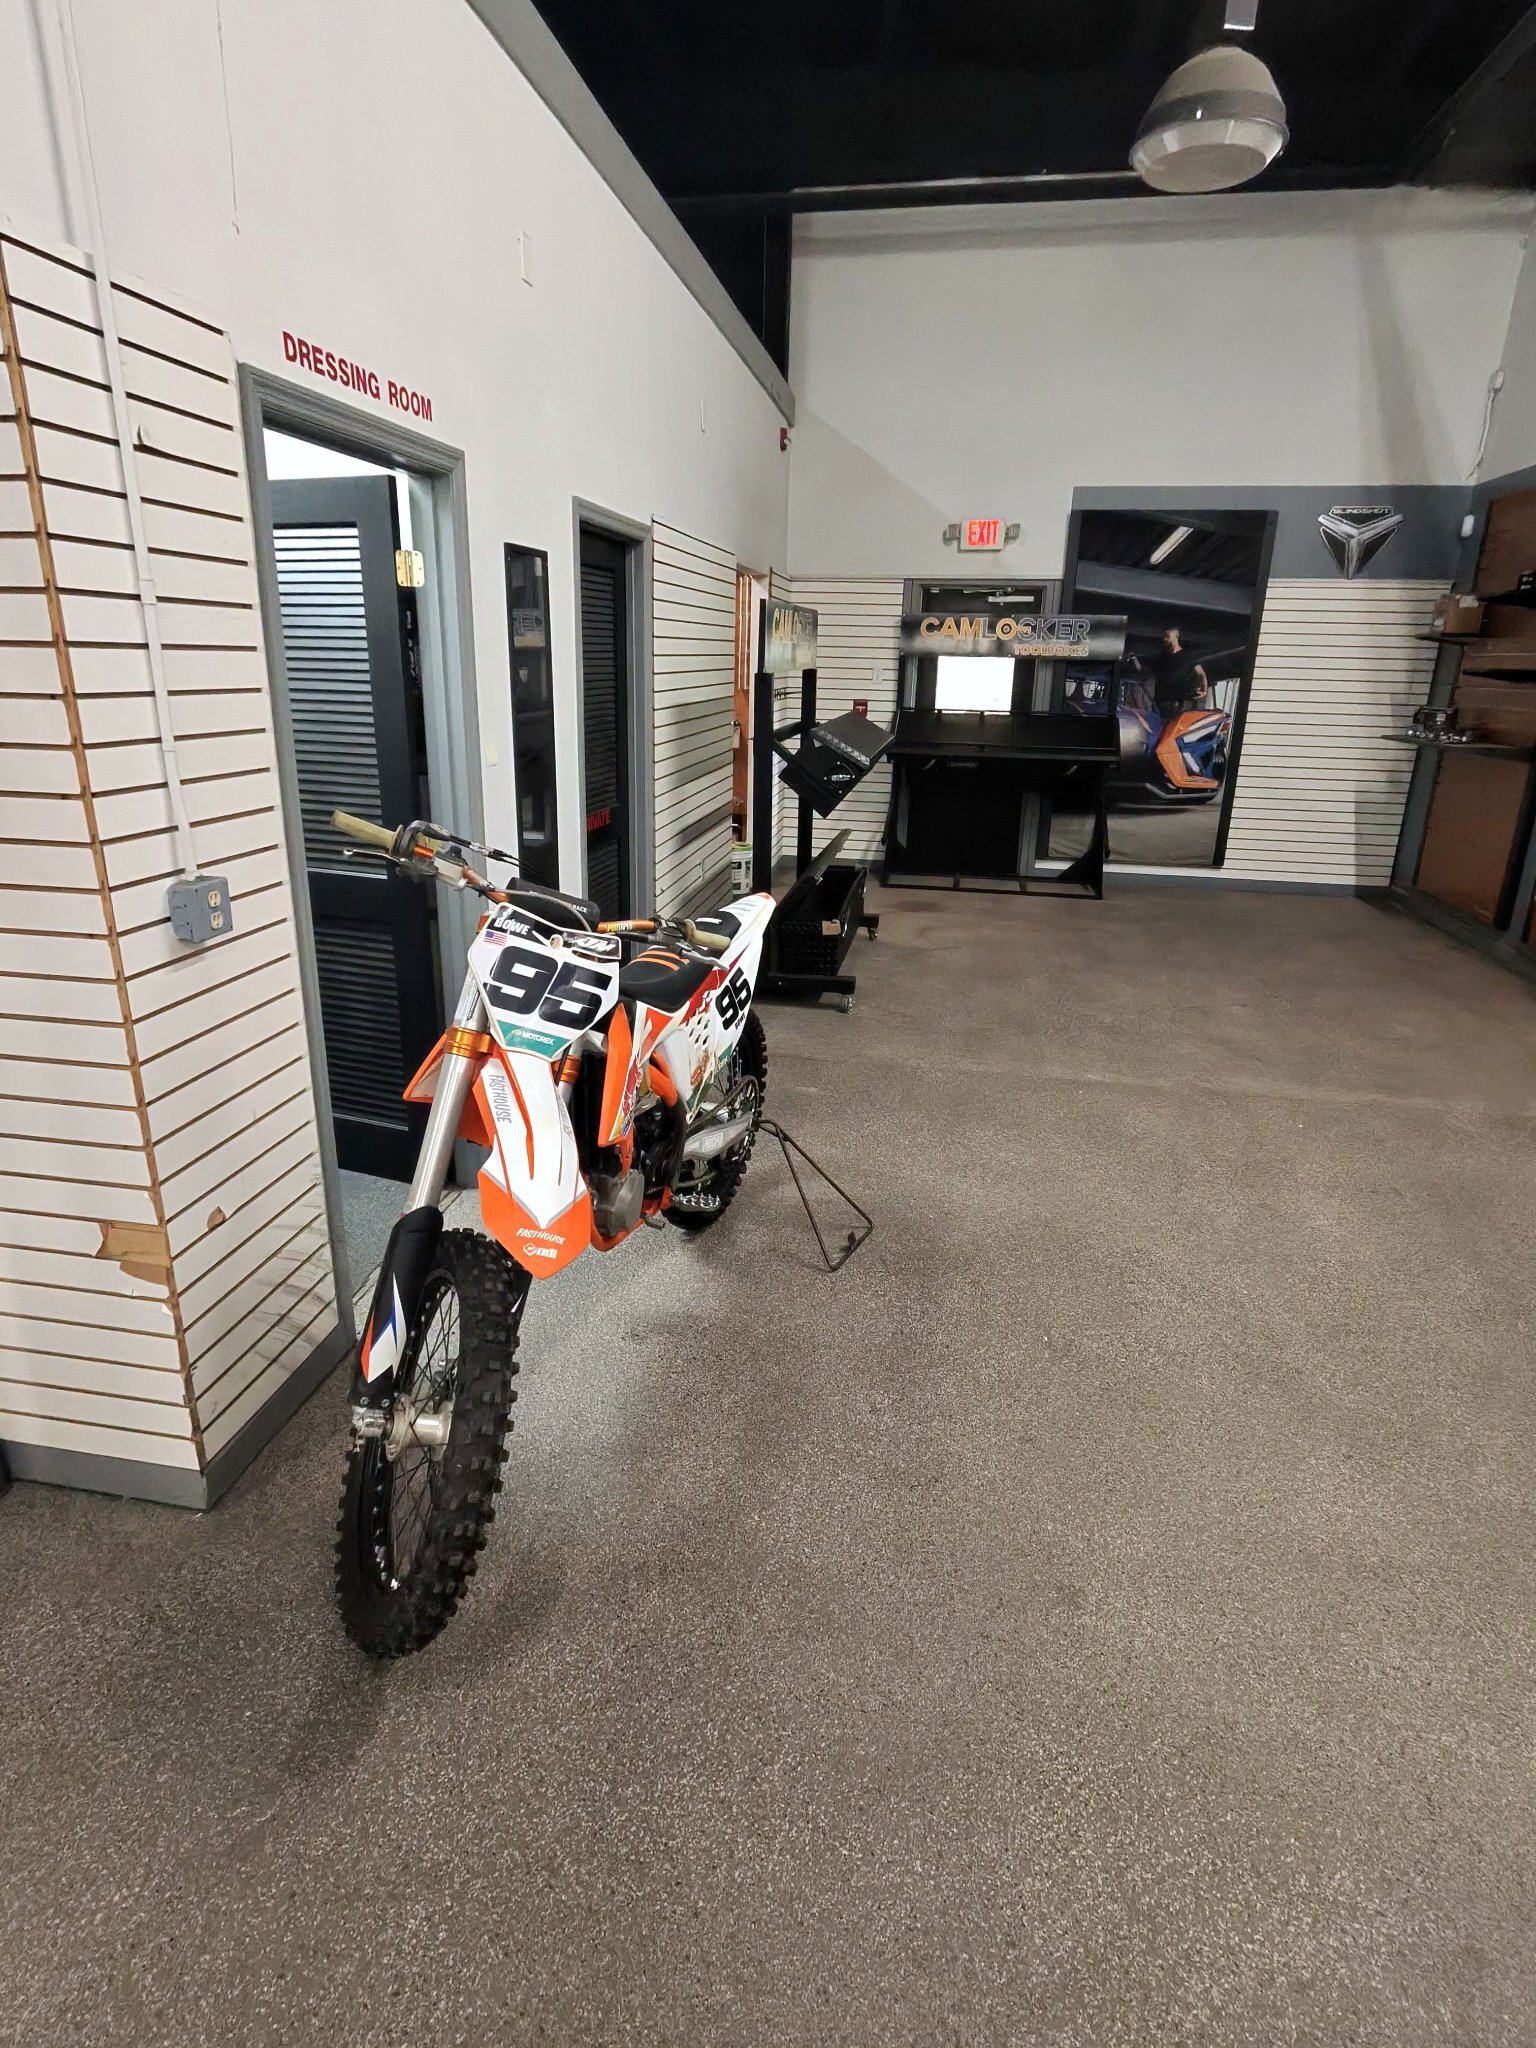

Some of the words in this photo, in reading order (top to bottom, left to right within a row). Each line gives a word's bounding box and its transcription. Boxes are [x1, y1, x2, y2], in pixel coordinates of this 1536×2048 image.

[282, 331, 380, 400] DRESSING
[387, 380, 433, 421] ROOM
[968, 520, 999, 545] EXIT
[920, 617, 1091, 642] CAMLOCKER
[1014, 643, 1089, 657] TOOLBOXES
[493, 917, 531, 935] BOWE
[482, 945, 613, 1031] 95
[715, 966, 752, 1031] 95
[521, 1030, 556, 1045] MOTOREX
[488, 1074, 512, 1124] FASTHOUSE
[516, 1228, 566, 1245] FASTHOUSE
